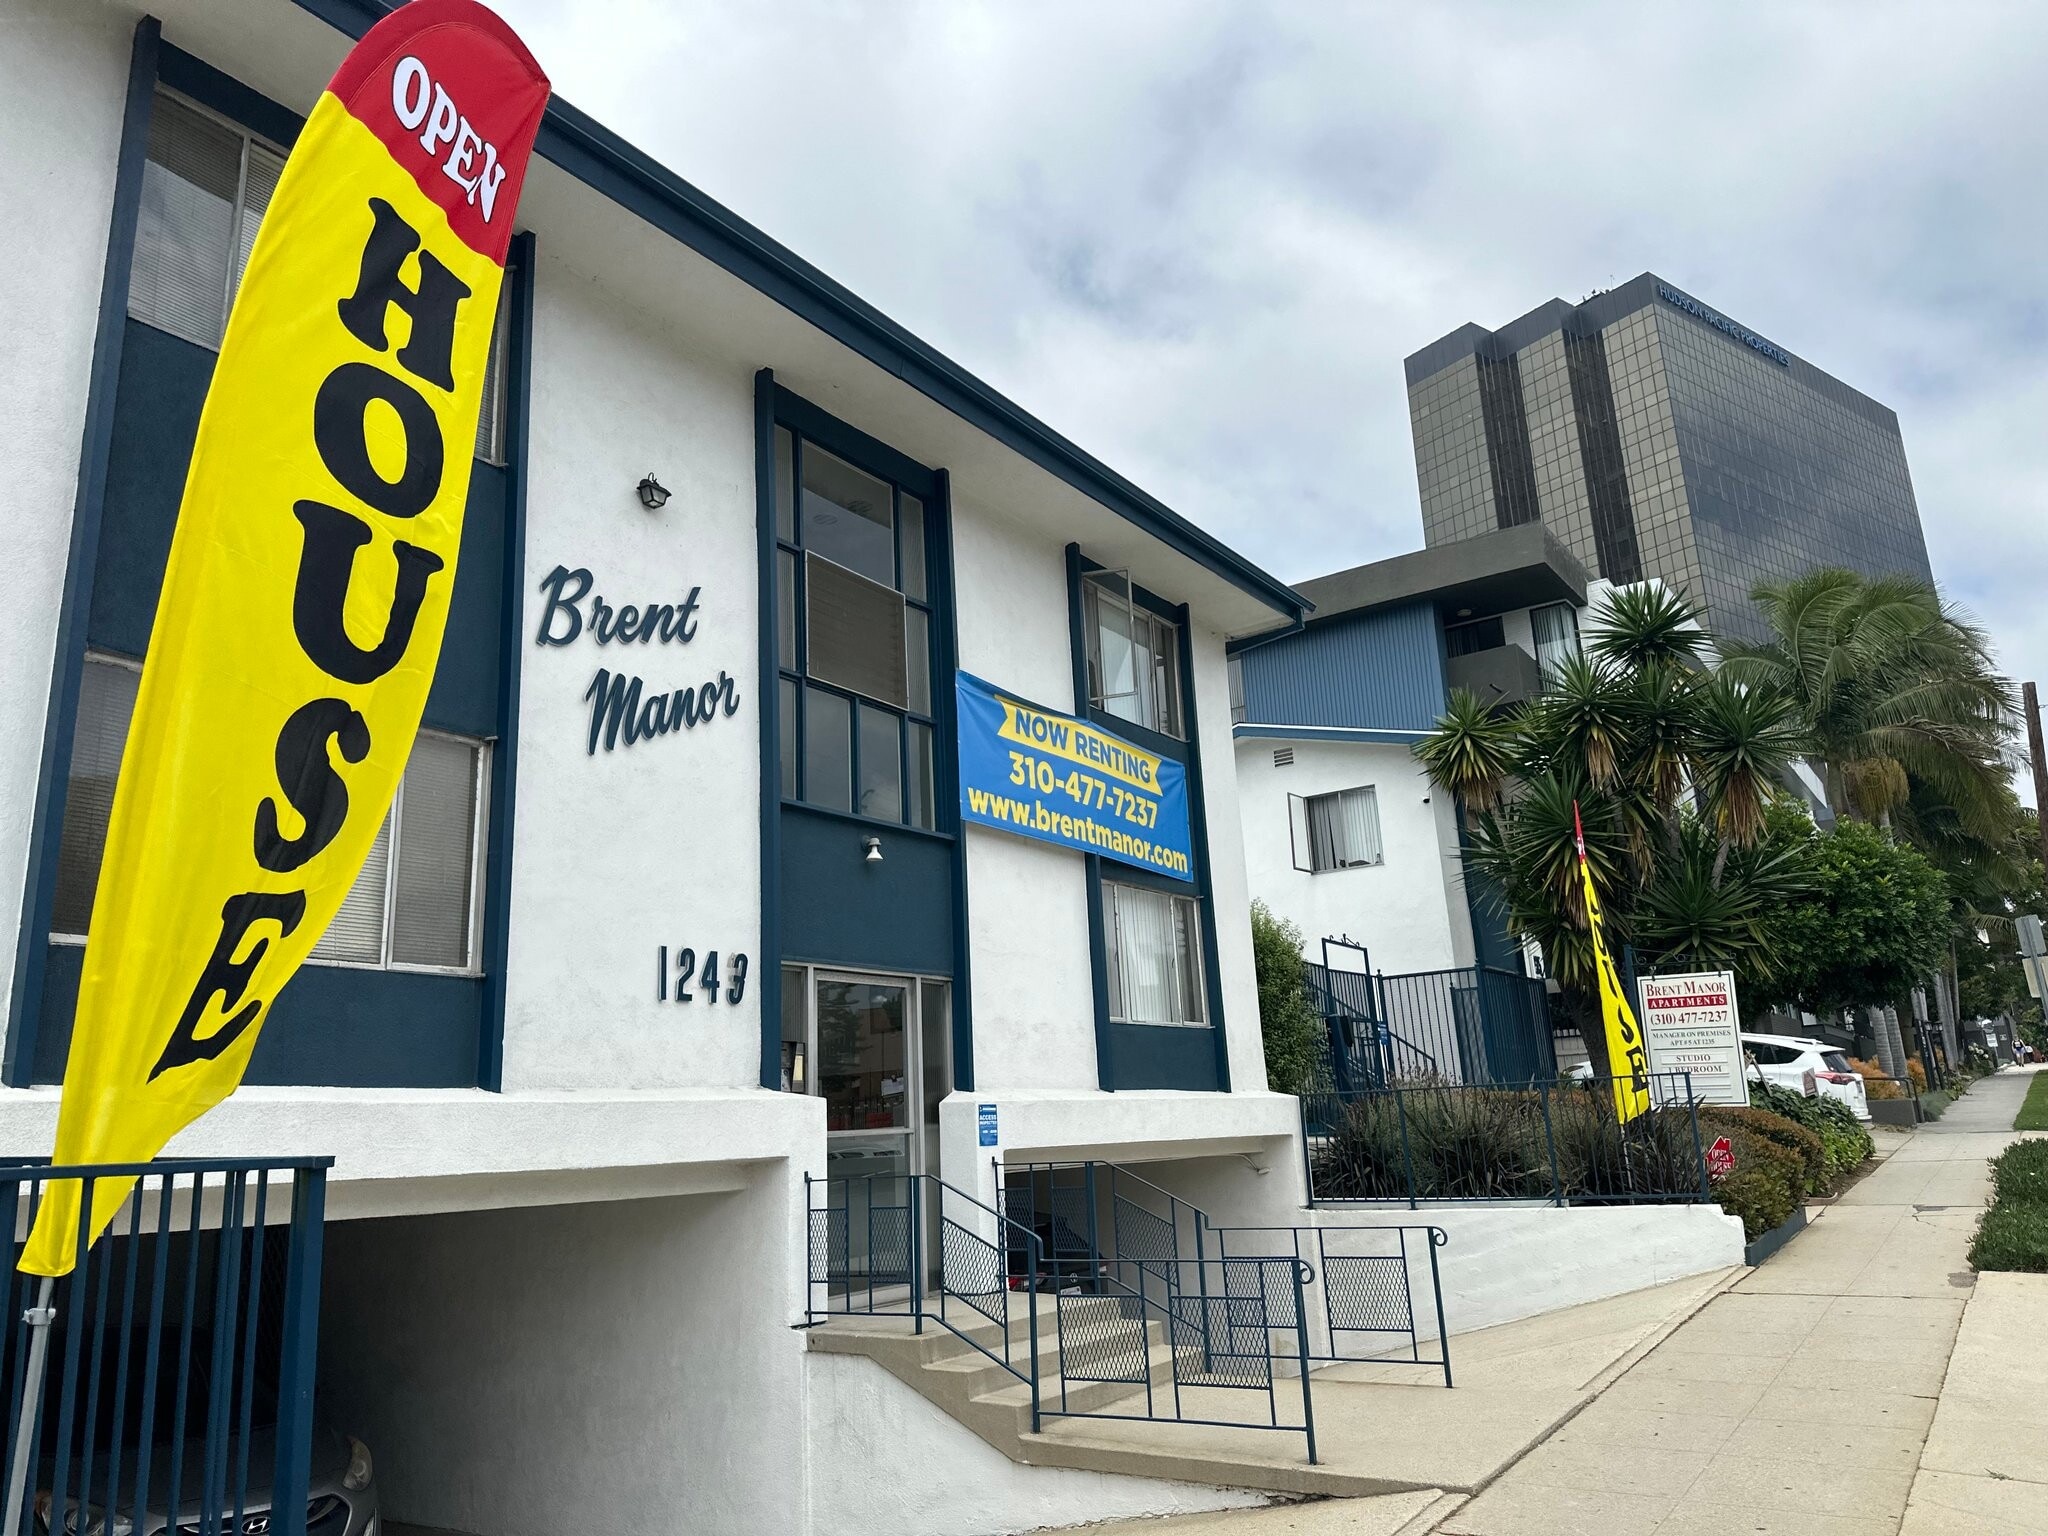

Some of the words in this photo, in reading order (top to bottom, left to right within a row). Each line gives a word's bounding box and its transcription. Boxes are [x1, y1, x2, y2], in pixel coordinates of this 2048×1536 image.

[392, 55, 507, 223] OPEN
[1658, 284, 1704, 319] HUDSON
[1704, 309, 1740, 339] PACIFIC
[1740, 329, 1790, 367] PROPERTIES
[146, 197, 472, 1085] HOUSE
[536, 564, 702, 647] Brent
[585, 667, 740, 756] Manor
[1015, 708, 1068, 750] NOW
[1075, 731, 1151, 784] RENTING
[1009, 750, 1158, 829] 310-477-7237
[967, 786, 1188, 873] www.brentmanor.com
[657, 945, 749, 1005] 1243
[1646, 984, 1682, 997] BRENT
[1683, 981, 1727, 994] MANOR
[1650, 996, 1725, 1008] APARTMENTS
[1650, 1013, 1676, 1026] (310)
[1678, 1010, 1728, 1024] 477-7237
[1652, 1031, 1686, 1039] MANAGER
[1675, 1065, 1722, 1073] BEDROOM
[1676, 1054, 1711, 1062] STUDIO
